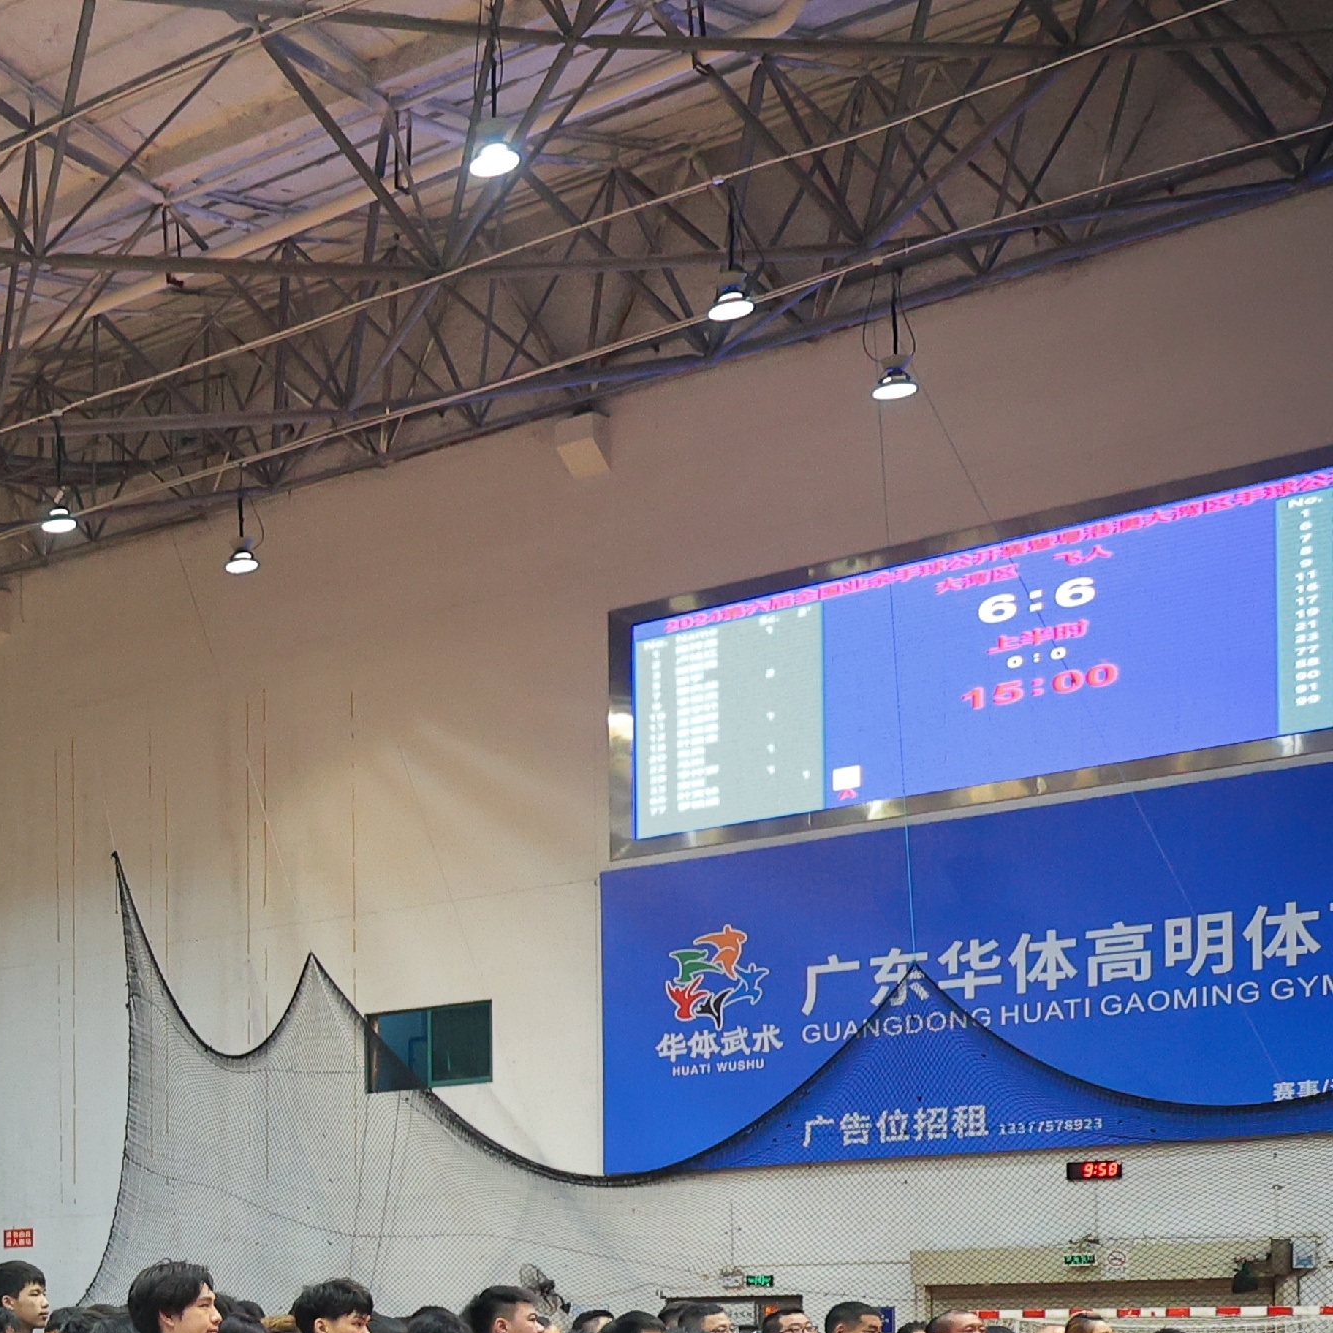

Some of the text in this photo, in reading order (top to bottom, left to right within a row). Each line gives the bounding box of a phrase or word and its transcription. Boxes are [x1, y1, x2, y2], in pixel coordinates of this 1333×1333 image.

[978, 577, 1096, 624] 6:6
[961, 663, 1120, 710] 15:00
[801, 901, 1333, 1017] 广东华体高明体
[801, 1008, 992, 1045] GUANGDONG
[1000, 1000, 1091, 1024] HUATI
[1099, 982, 1260, 1016] GAOMING
[655, 1024, 784, 1063] 华体武术
[672, 1058, 765, 1076] HUATI WUSHU
[1273, 1078, 1333, 1101] 赛事/
[803, 1104, 989, 1147] 广告位招租
